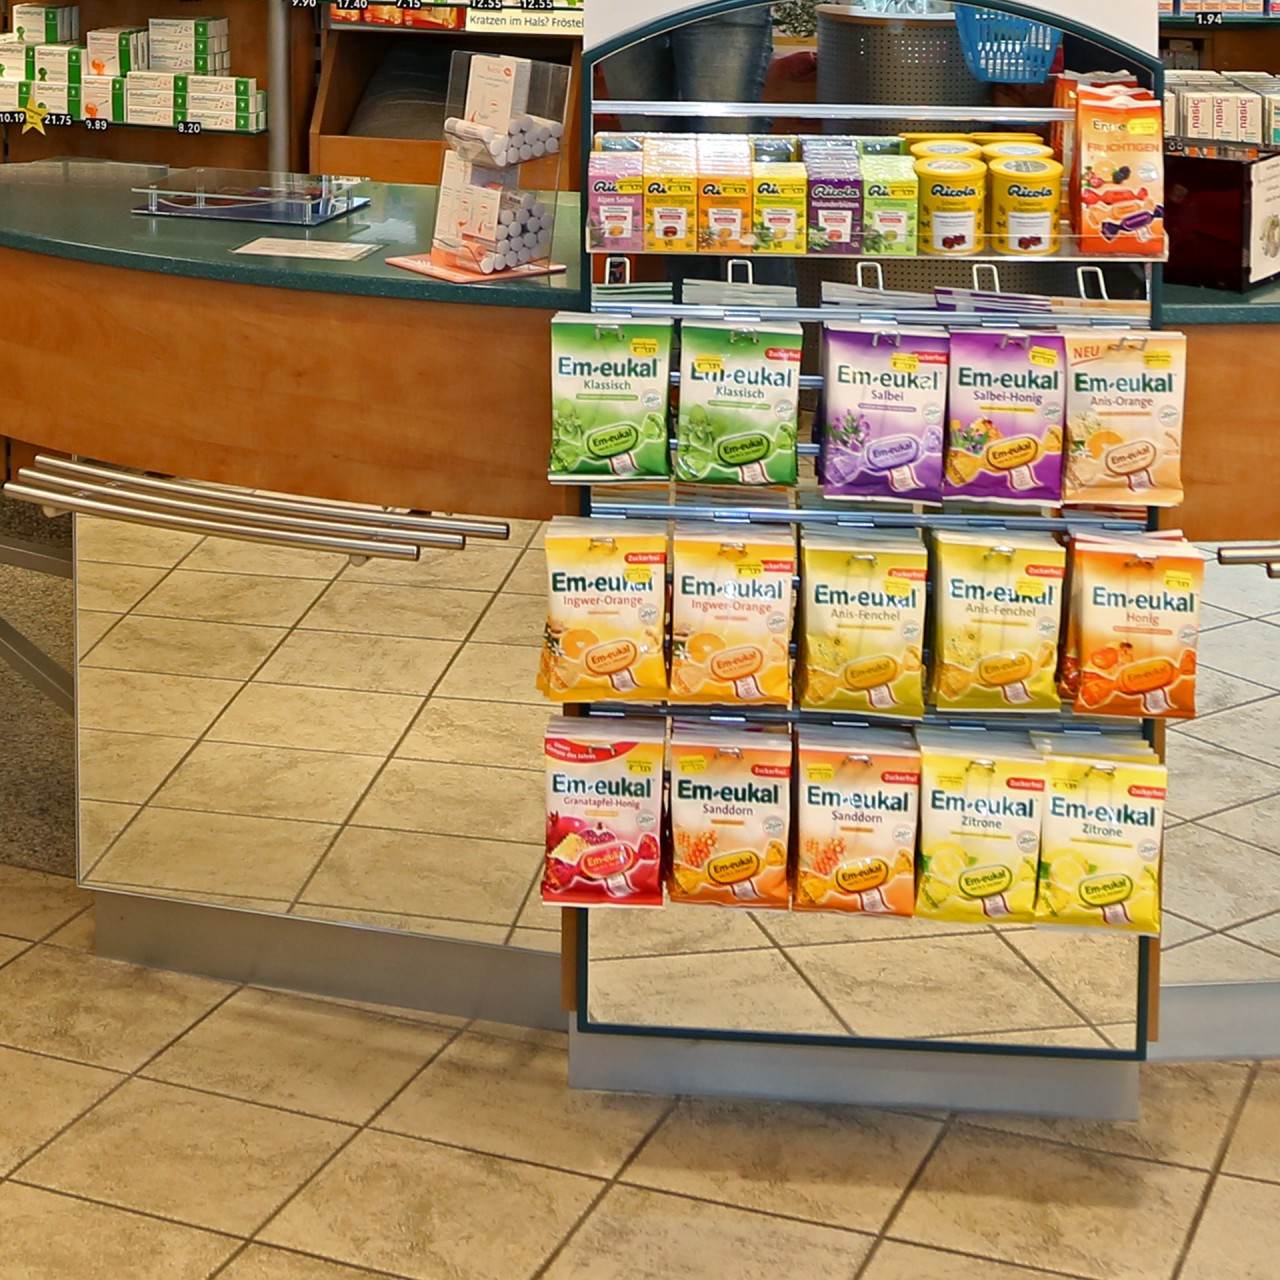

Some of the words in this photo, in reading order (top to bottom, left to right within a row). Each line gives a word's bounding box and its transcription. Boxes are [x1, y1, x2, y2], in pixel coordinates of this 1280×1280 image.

[470, 16, 506, 25] Kratzen
[510, 16, 522, 25] im
[524, 16, 549, 26] Hals?
[179, 123, 200, 132] 8.20
[1073, 346, 1100, 360] NEU
[583, 379, 630, 391] Klassisch
[715, 387, 764, 399] Klassisch
[871, 389, 904, 401] Salbei
[973, 391, 1042, 404] Salbei-Honig
[1090, 395, 1153, 408] Anis-Orange
[563, 595, 643, 608] Ingwer-Orange
[691, 600, 772, 614] Ingwer-Orange
[831, 609, 900, 621] Anis-Fenchel
[965, 605, 1036, 617] Anis-Fenchel
[1126, 613, 1159, 626] Honig
[703, 804, 754, 816] Sanddorn
[831, 810, 883, 823] Sanddorn
[961, 817, 1002, 830] Zitrone
[1082, 825, 1123, 838] Zitrone
